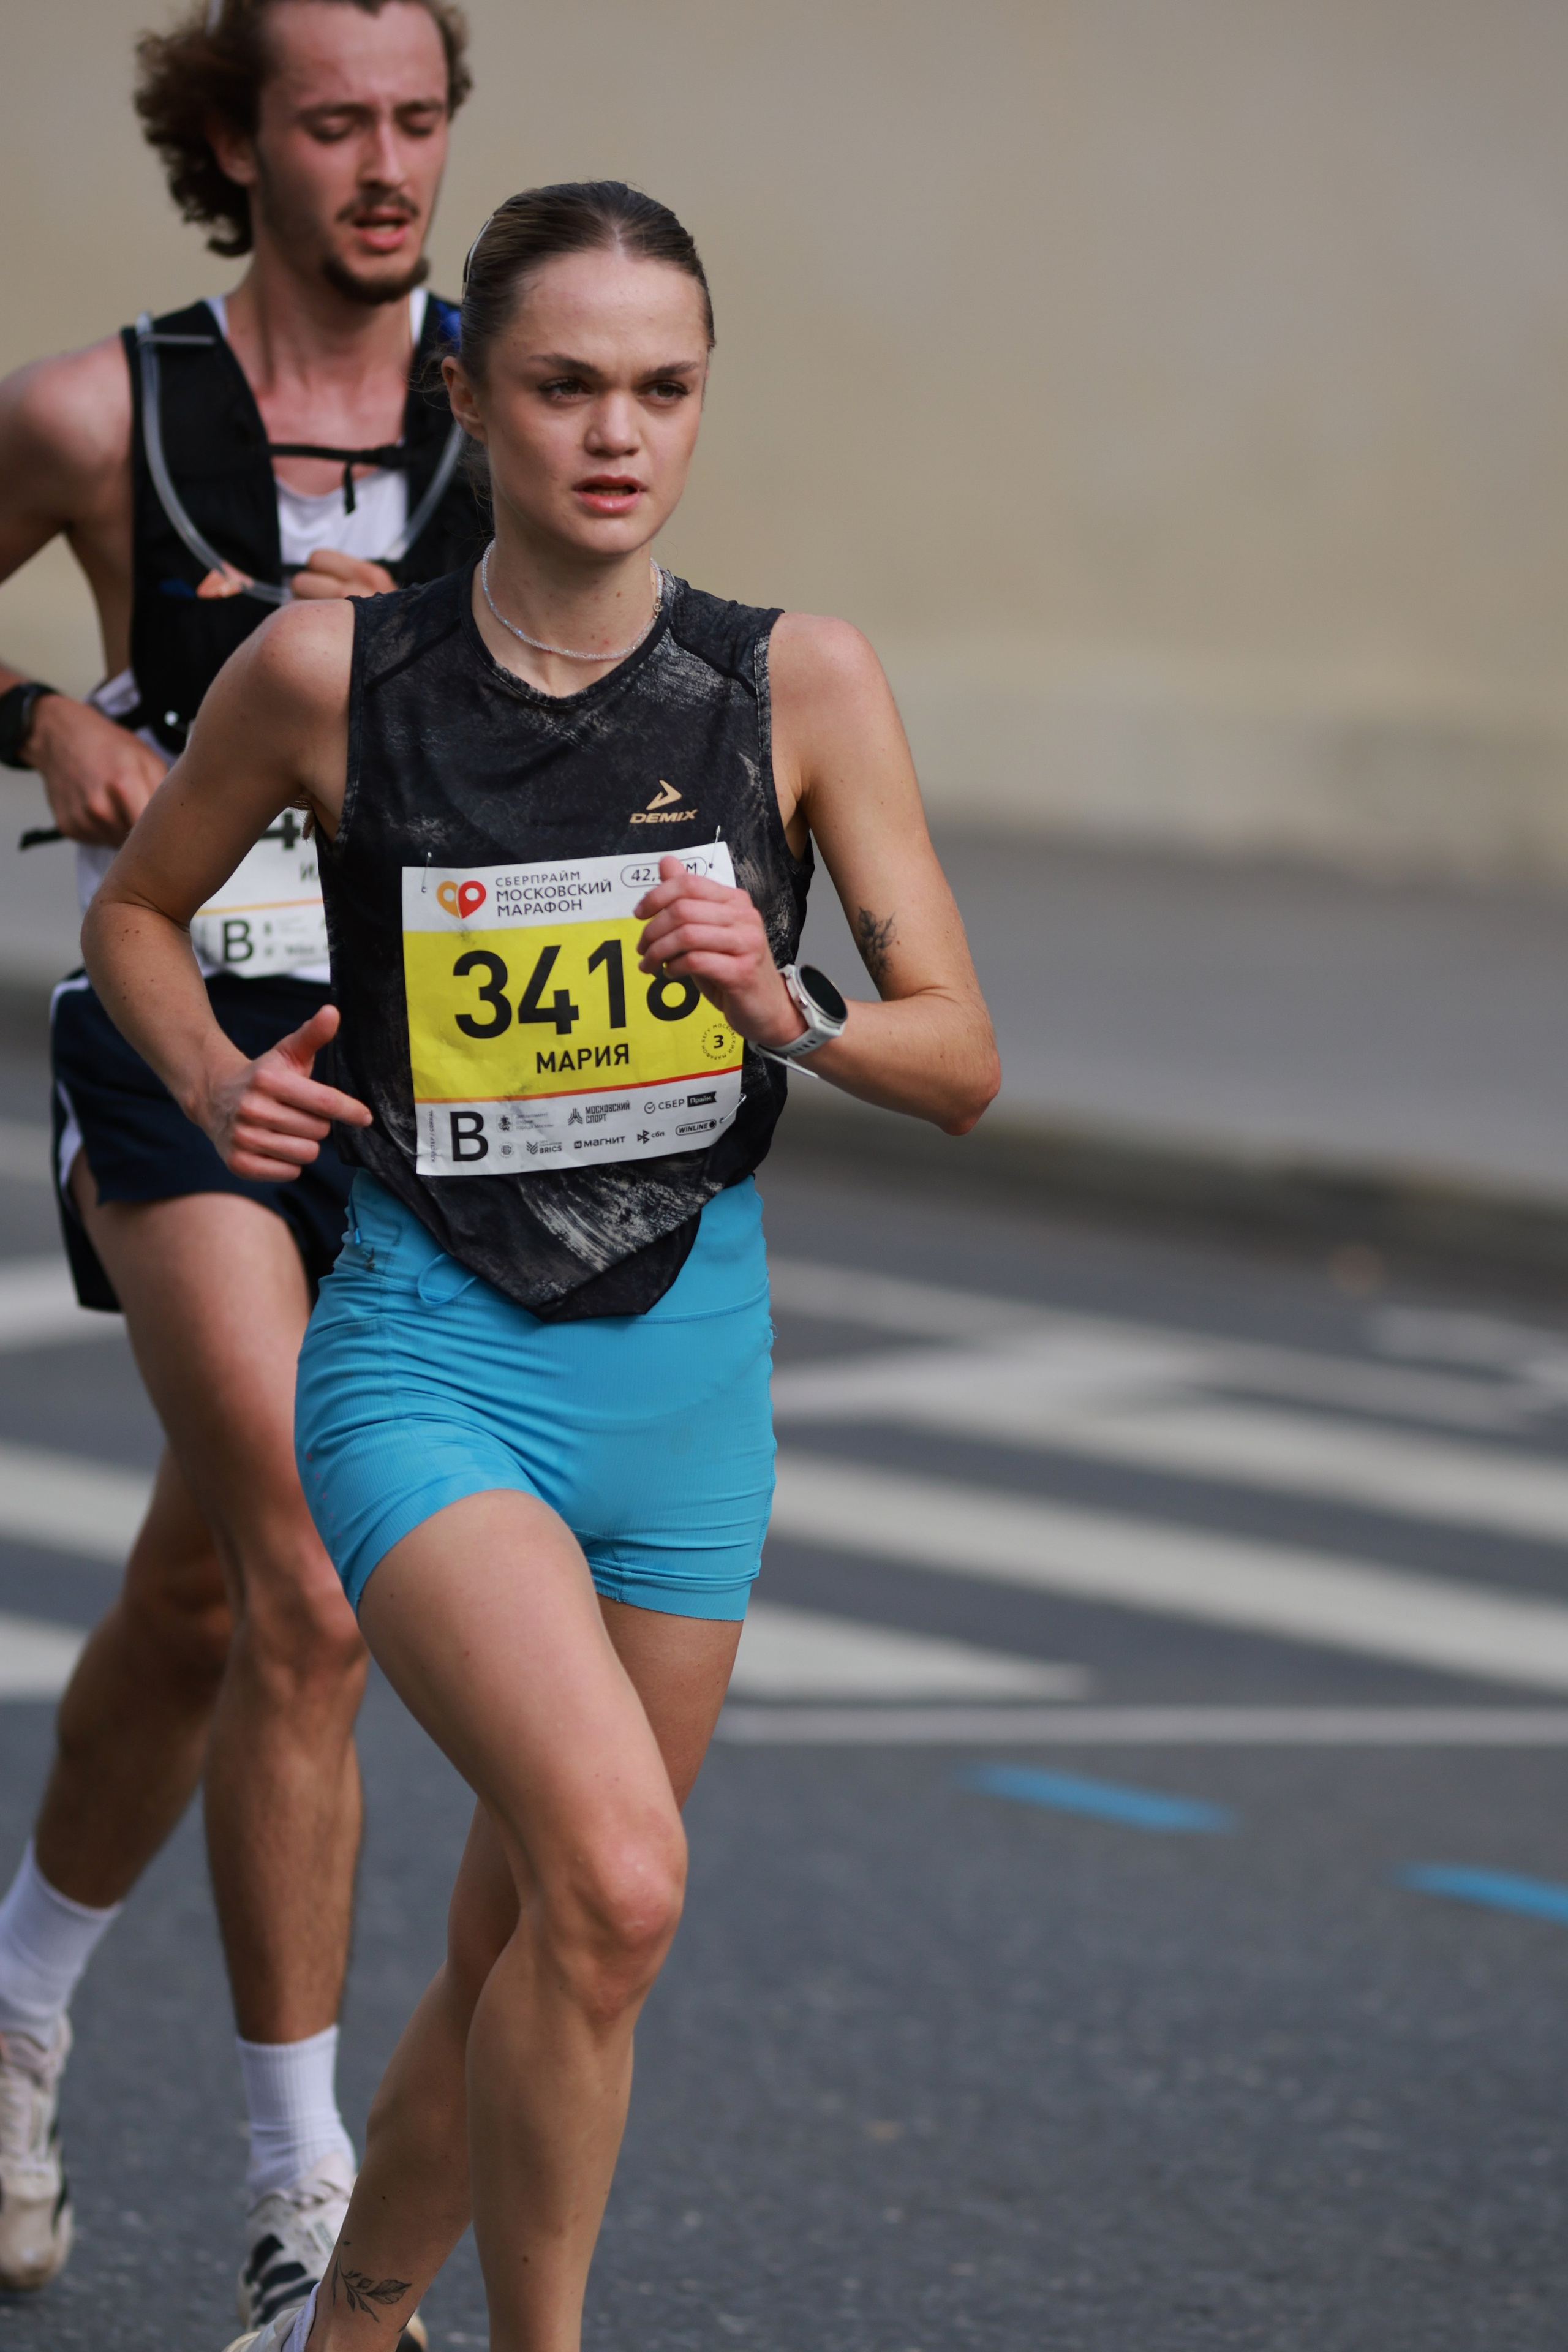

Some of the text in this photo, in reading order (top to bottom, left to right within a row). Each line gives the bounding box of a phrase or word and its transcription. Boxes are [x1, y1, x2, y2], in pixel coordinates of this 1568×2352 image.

[630, 809, 698, 824] DEMIX
[495, 870, 580, 888] СБЕРПРАЙМ
[631, 868, 662, 882] 42,
[496, 878, 612, 902] МОСКОВСКИЙ
[497, 899, 582, 917] МАРАФОН
[222, 920, 254, 963] B
[453, 938, 701, 1039] 3418
[714, 1034, 724, 1049] 3
[535, 1043, 630, 1074] МАРИЯ
[586, 1100, 630, 1114] МОСКОВСКИЙ
[658, 1095, 712, 1110] СБЕР Прайм
[586, 1114, 606, 1124] СПОРТ
[679, 1123, 708, 1133] WINLINE
[450, 1111, 489, 1162] B
[539, 1145, 562, 1154] BRICS
